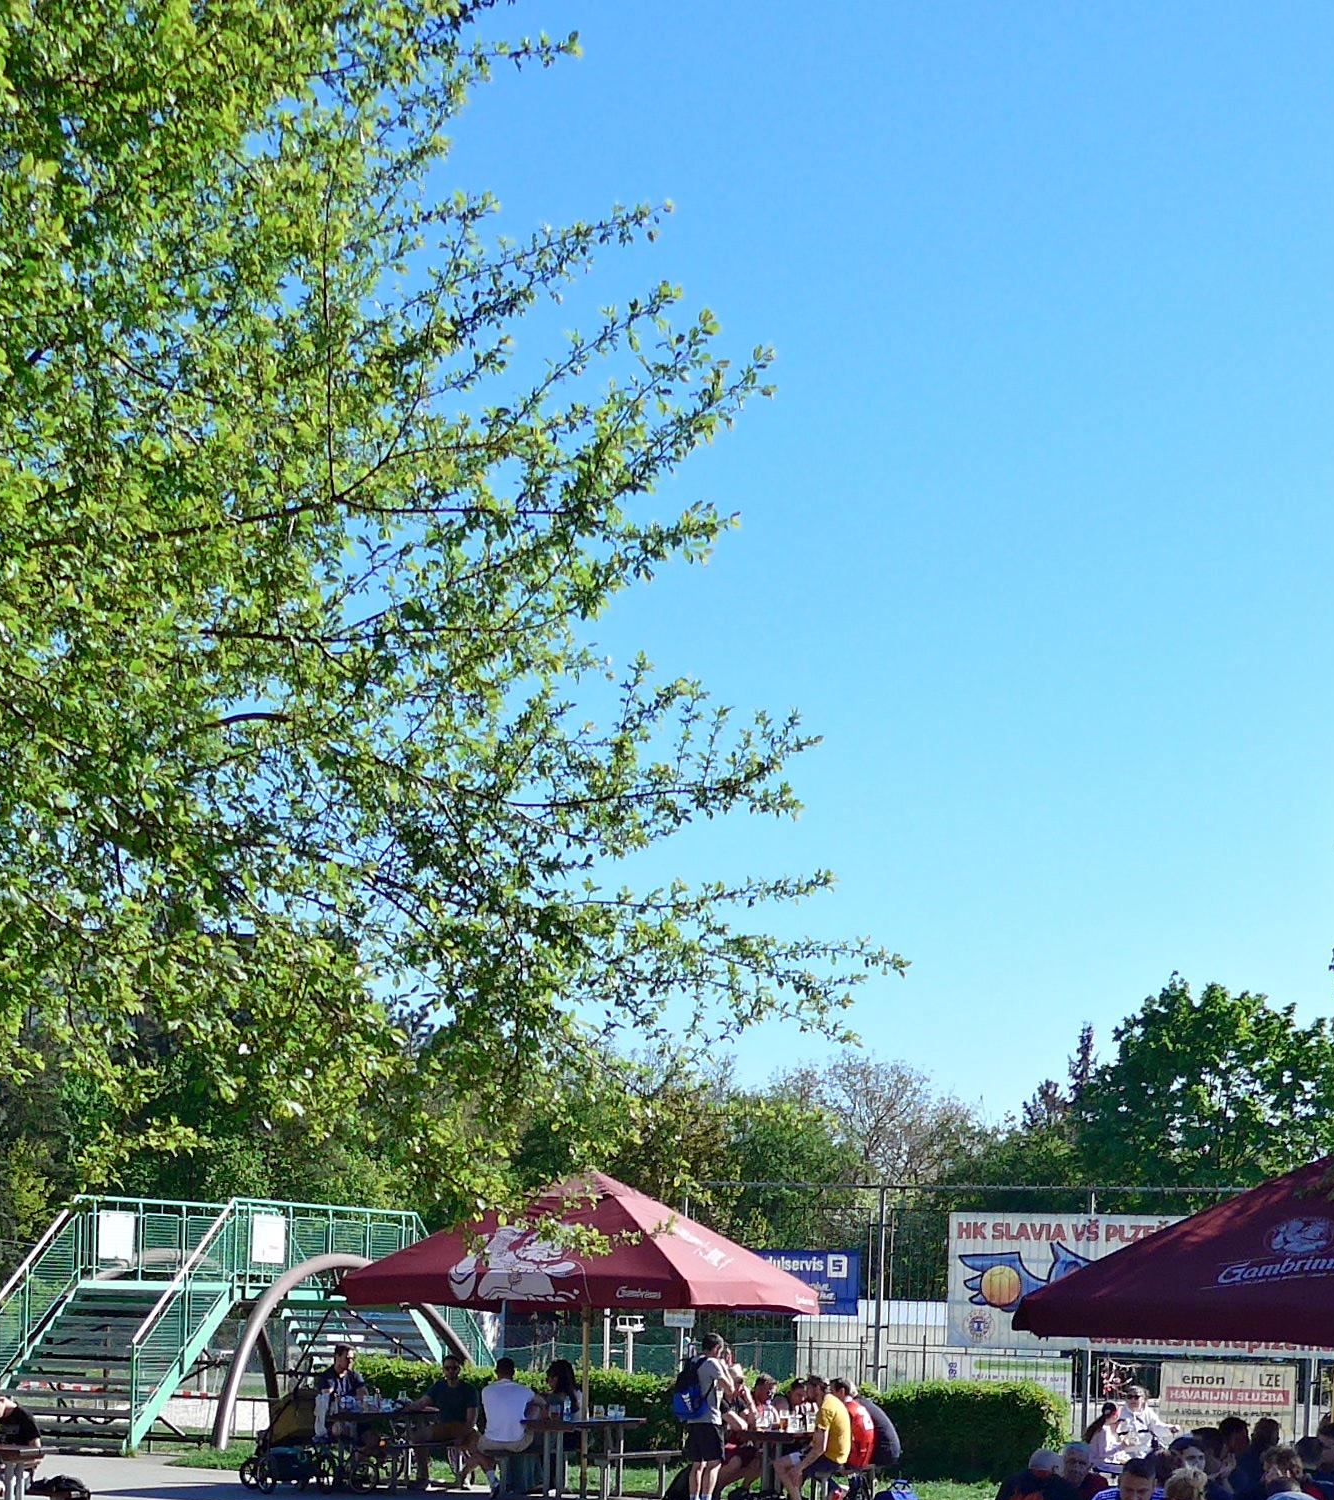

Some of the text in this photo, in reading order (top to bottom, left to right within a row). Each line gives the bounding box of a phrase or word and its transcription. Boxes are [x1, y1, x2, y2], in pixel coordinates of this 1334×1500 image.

[958, 1221, 987, 1240] HK
[992, 1222, 1067, 1242] SLAVIA
[1072, 1218, 1099, 1242] VŠ
[1182, 1374, 1225, 1386] emon
